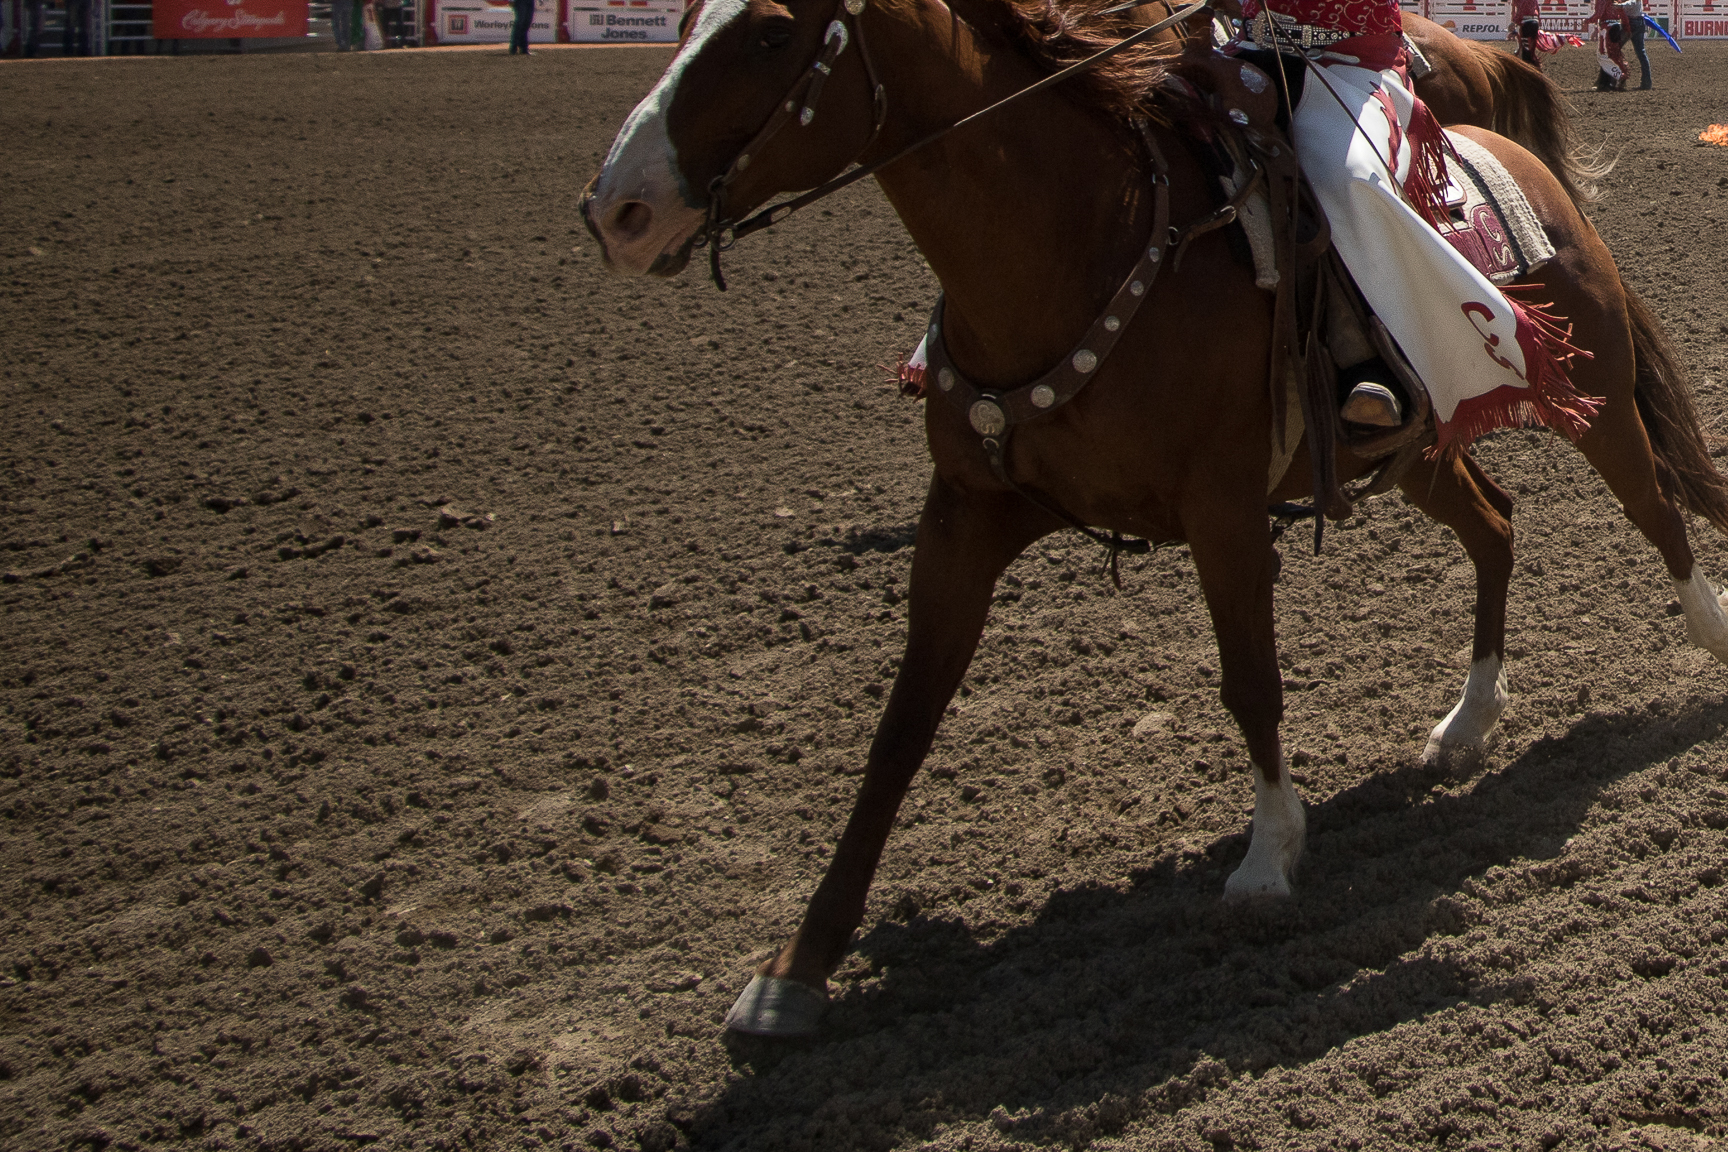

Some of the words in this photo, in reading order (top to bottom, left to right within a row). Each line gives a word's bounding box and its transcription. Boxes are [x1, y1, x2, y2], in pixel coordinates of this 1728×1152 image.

[606, 14, 666, 26] Bennett
[601, 27, 647, 39] Jones
[1462, 24, 1501, 33] REPSOL
